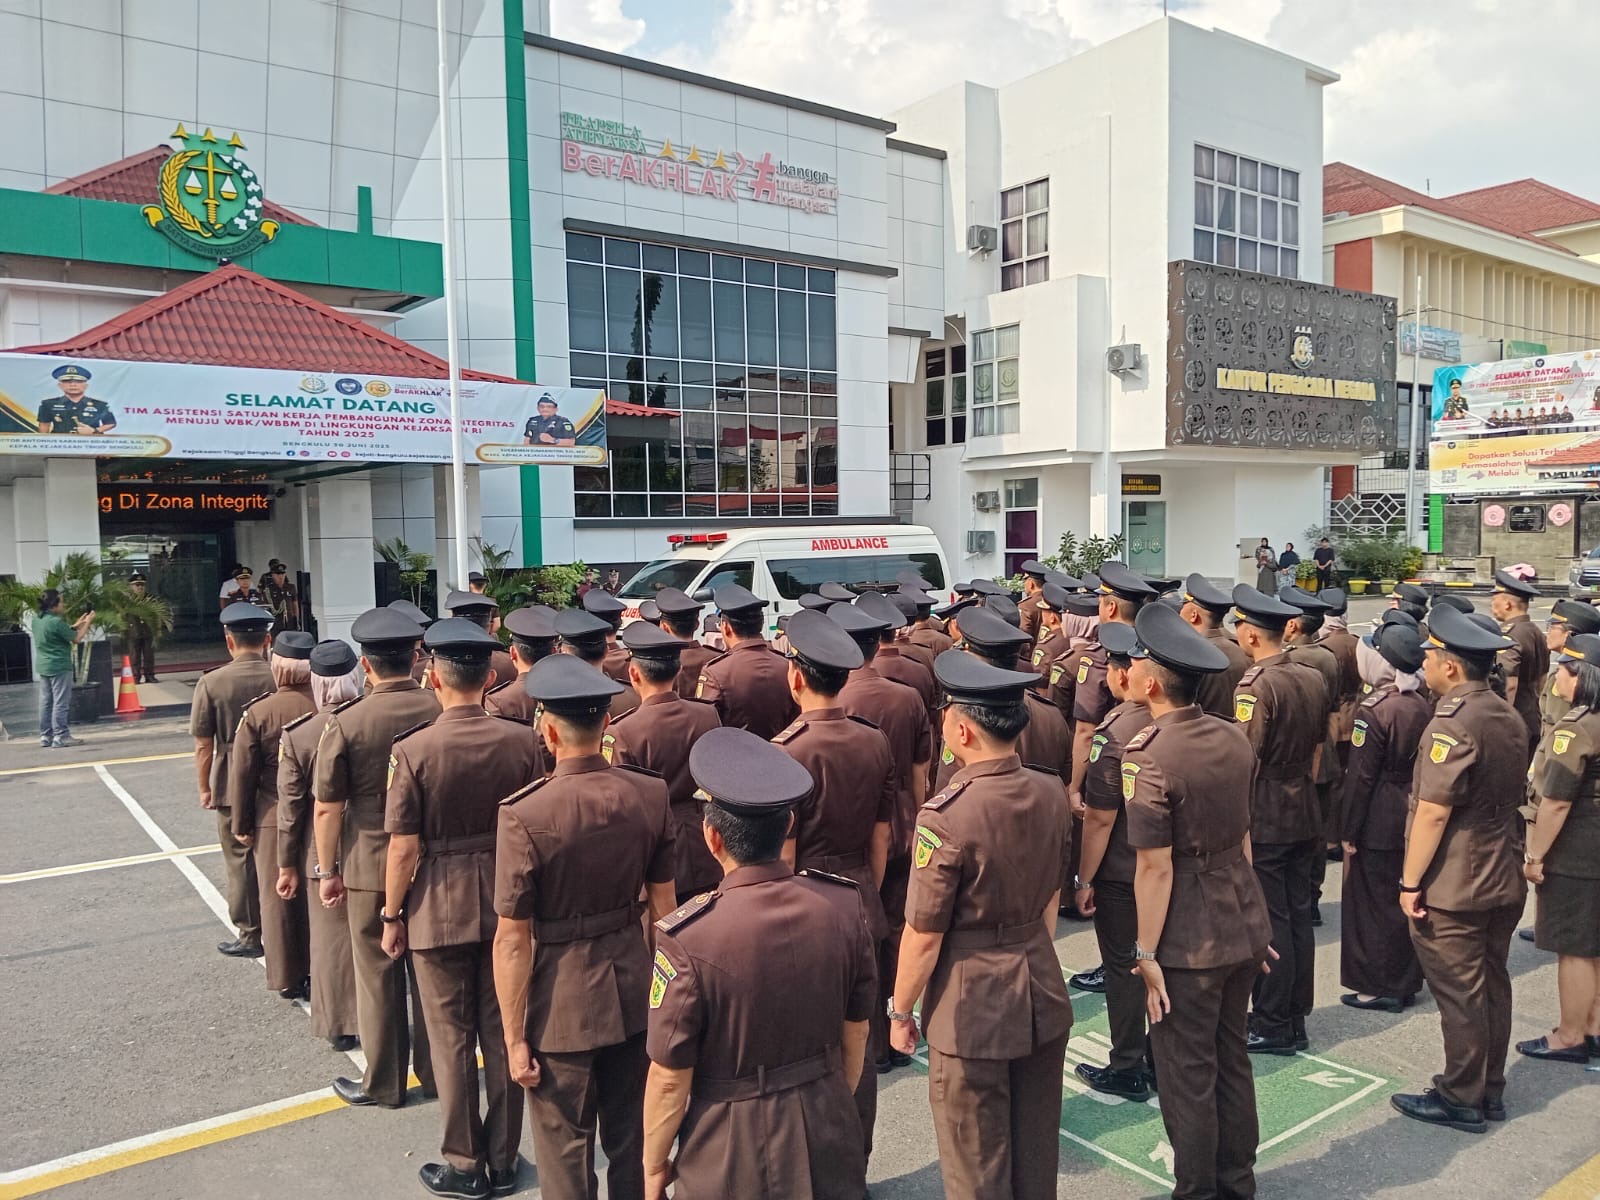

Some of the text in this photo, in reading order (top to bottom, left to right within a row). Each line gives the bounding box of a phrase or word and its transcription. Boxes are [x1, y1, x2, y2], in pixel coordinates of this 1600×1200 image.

[562, 140, 738, 202] BerAKHLAK
[779, 160, 829, 184] bangga
[1534, 366, 1571, 376] DATANG
[394, 388, 442, 397] BerAKHLAK
[225, 393, 436, 414] SELAMAT DATANG
[153, 408, 222, 416] ASISTENSI
[227, 410, 278, 418] SATUAN
[283, 412, 321, 420] KERJA
[325, 413, 414, 423] PEMBANGUNAN
[419, 417, 451, 425] ZONA
[460, 419, 515, 428] NTEGRITAS
[165, 417, 220, 425] MENUJU
[224, 418, 300, 428] WBK/WBBM
[320, 421, 399, 431] LINGKUNGAN
[403, 425, 468, 434] KEJAKSAN
[300, 429, 375, 438] TAHUN 2025
[1468, 452, 1511, 460] Dapatkan
[1512, 449, 1538, 458] Solusi
[1461, 461, 1522, 469] Permasalahan
[119, 493, 140, 509] Di
[146, 493, 193, 509] Zona
[811, 537, 889, 552] AMBULANCE
